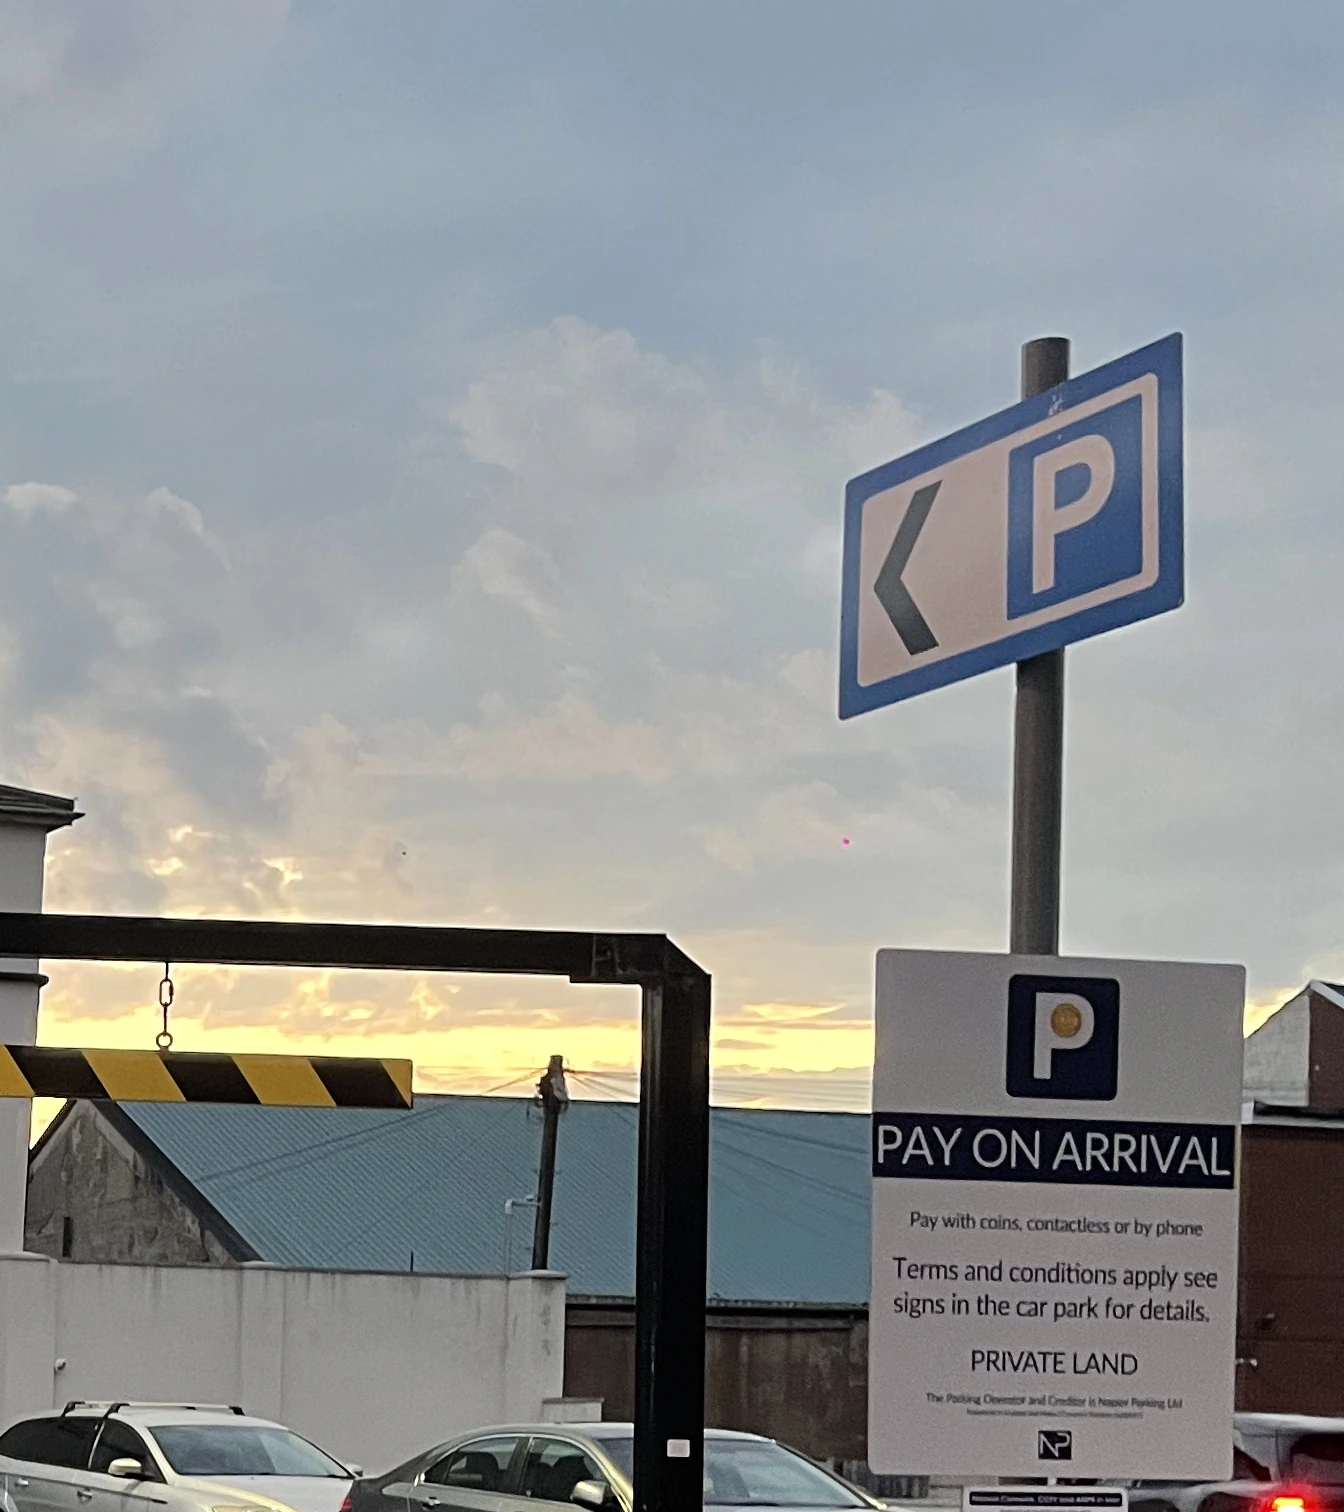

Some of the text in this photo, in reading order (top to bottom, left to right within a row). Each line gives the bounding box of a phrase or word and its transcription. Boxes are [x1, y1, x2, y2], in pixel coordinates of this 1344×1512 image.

[1032, 433, 1116, 595] P
[1032, 991, 1096, 1081] P
[877, 1124, 1232, 1176] PAY ON ARRIVAL
[910, 1210, 1204, 1238] Pay with coins, contactless or by phone
[892, 1256, 1218, 1292] Terms and conditions apply see
[893, 1290, 1210, 1323] signs in the car park for details.
[971, 1349, 1138, 1376] PRIVATE LAND
